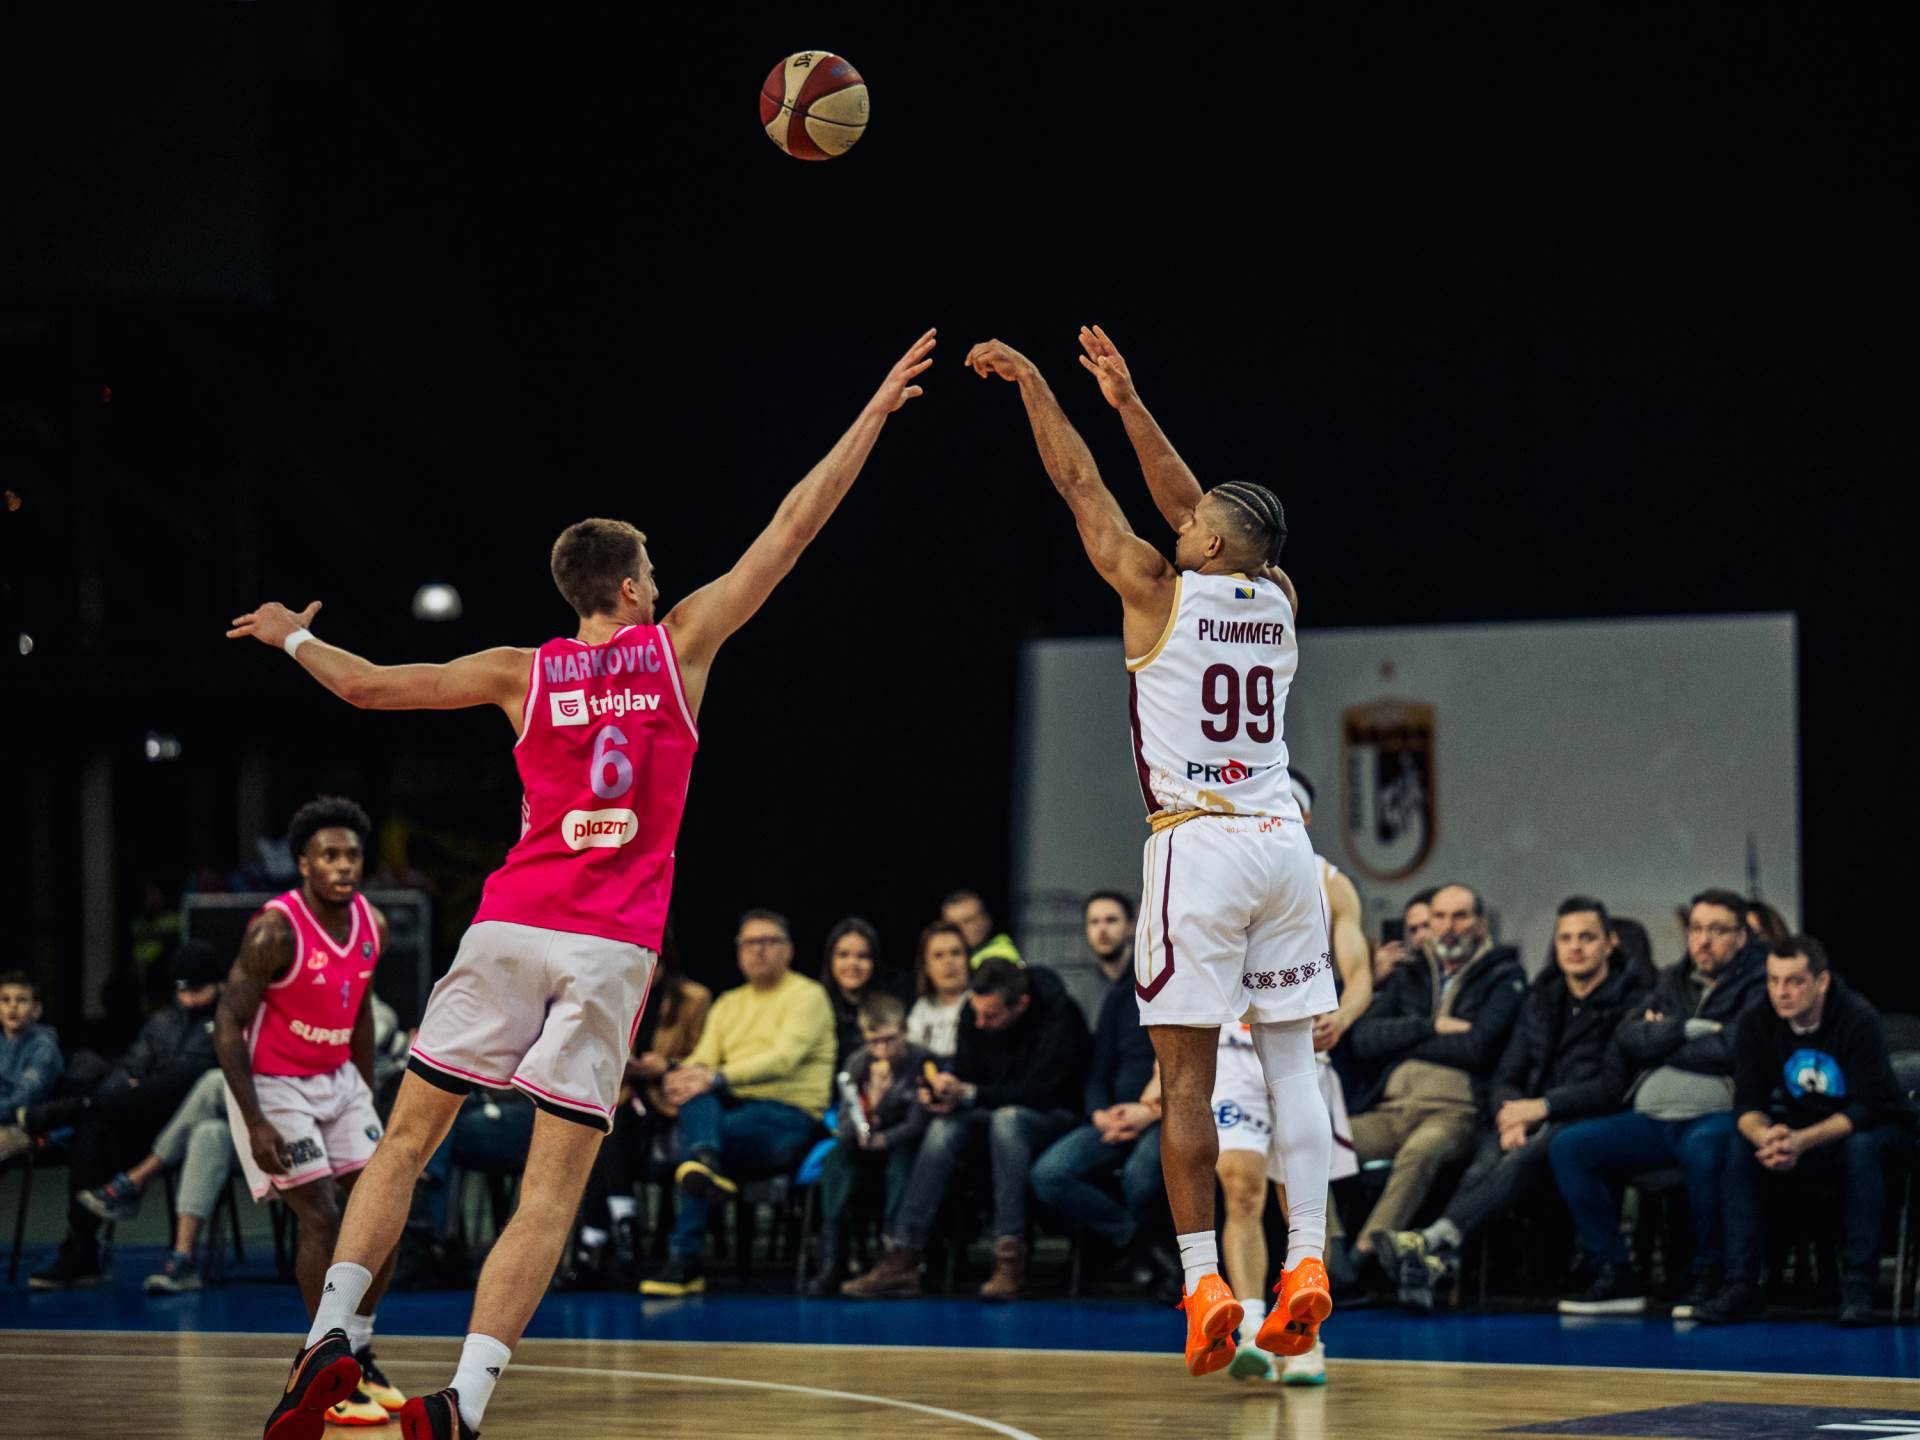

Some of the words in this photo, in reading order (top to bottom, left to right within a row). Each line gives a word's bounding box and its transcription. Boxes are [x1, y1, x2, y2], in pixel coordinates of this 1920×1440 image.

[1198, 618, 1284, 645] PLUMMER
[544, 639, 661, 684] MARKOVIĆ
[590, 688, 660, 717] triglav
[1201, 663, 1275, 744] 99
[590, 725, 633, 799] 6
[290, 1019, 353, 1046] SUPER
